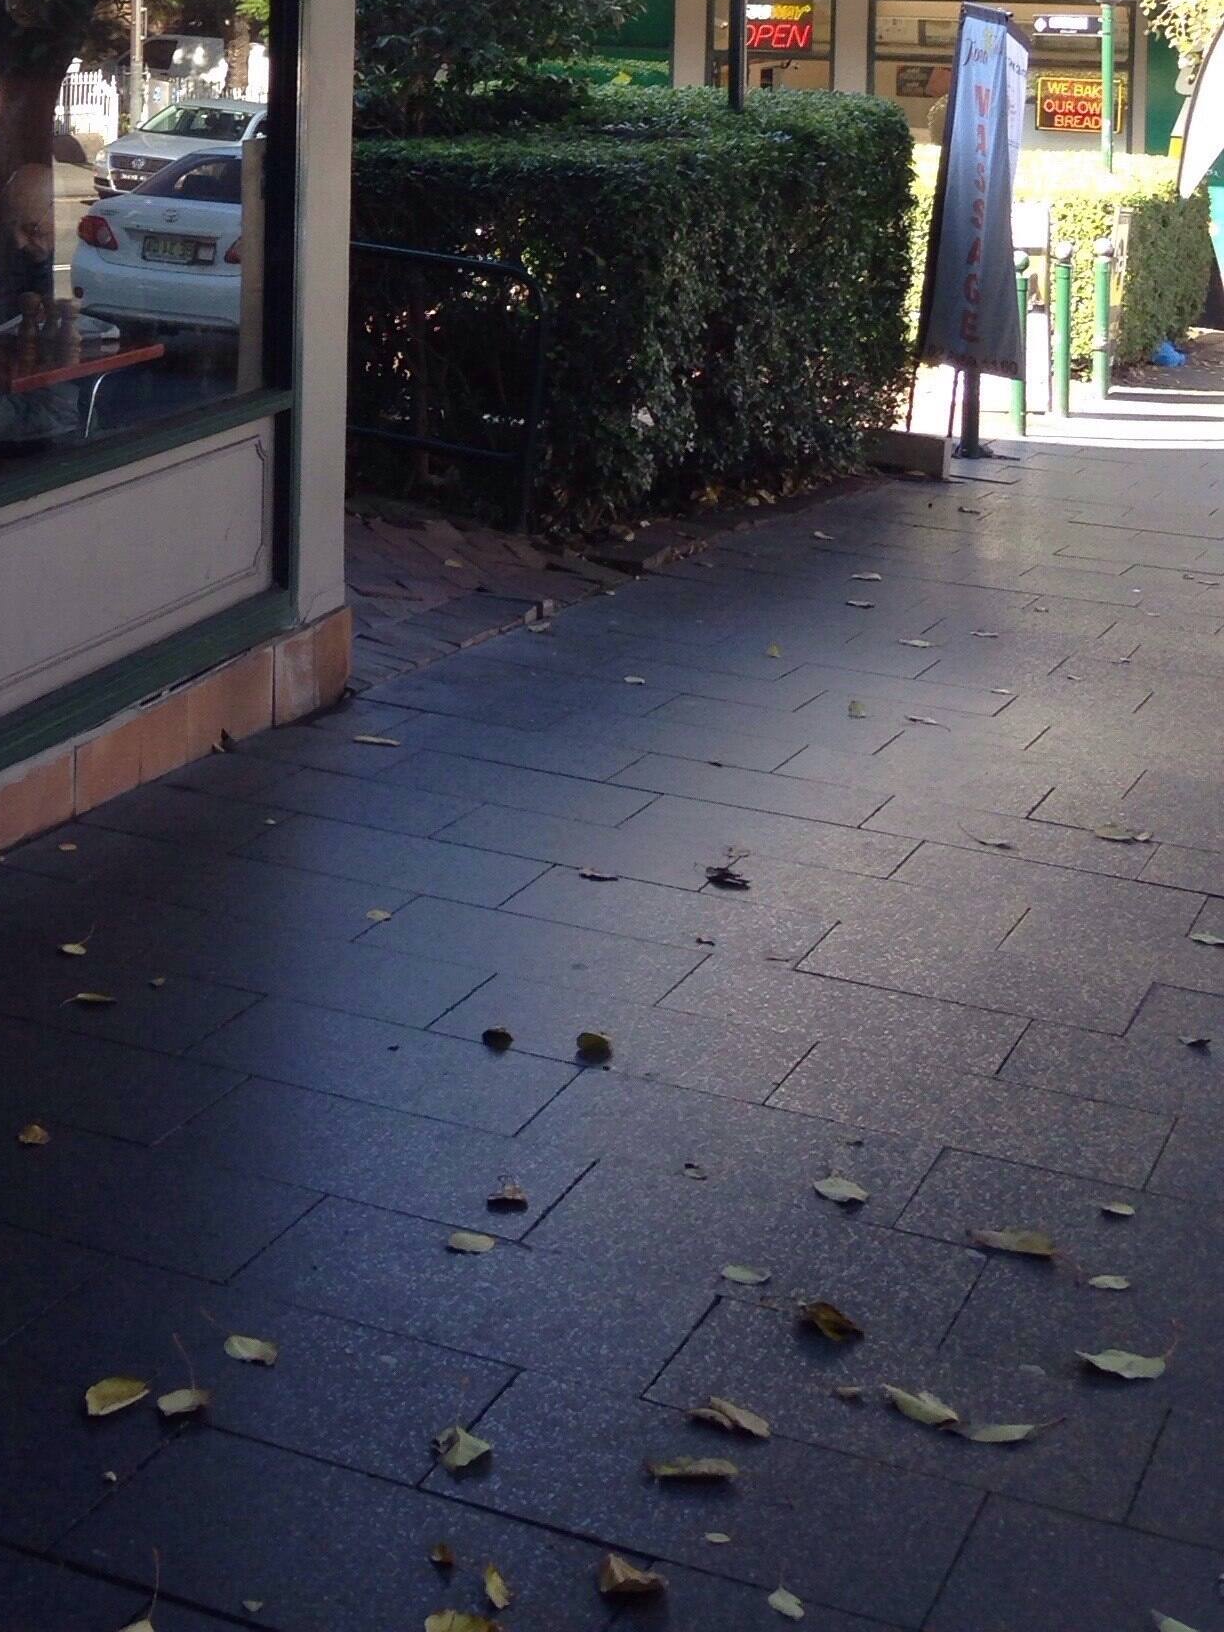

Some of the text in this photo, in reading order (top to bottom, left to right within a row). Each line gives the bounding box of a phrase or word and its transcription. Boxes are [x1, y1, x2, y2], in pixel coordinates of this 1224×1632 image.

[1047, 81, 1103, 98] WE BAK
[1043, 99, 1103, 115] OUR OW
[1054, 114, 1103, 129] BREAD
